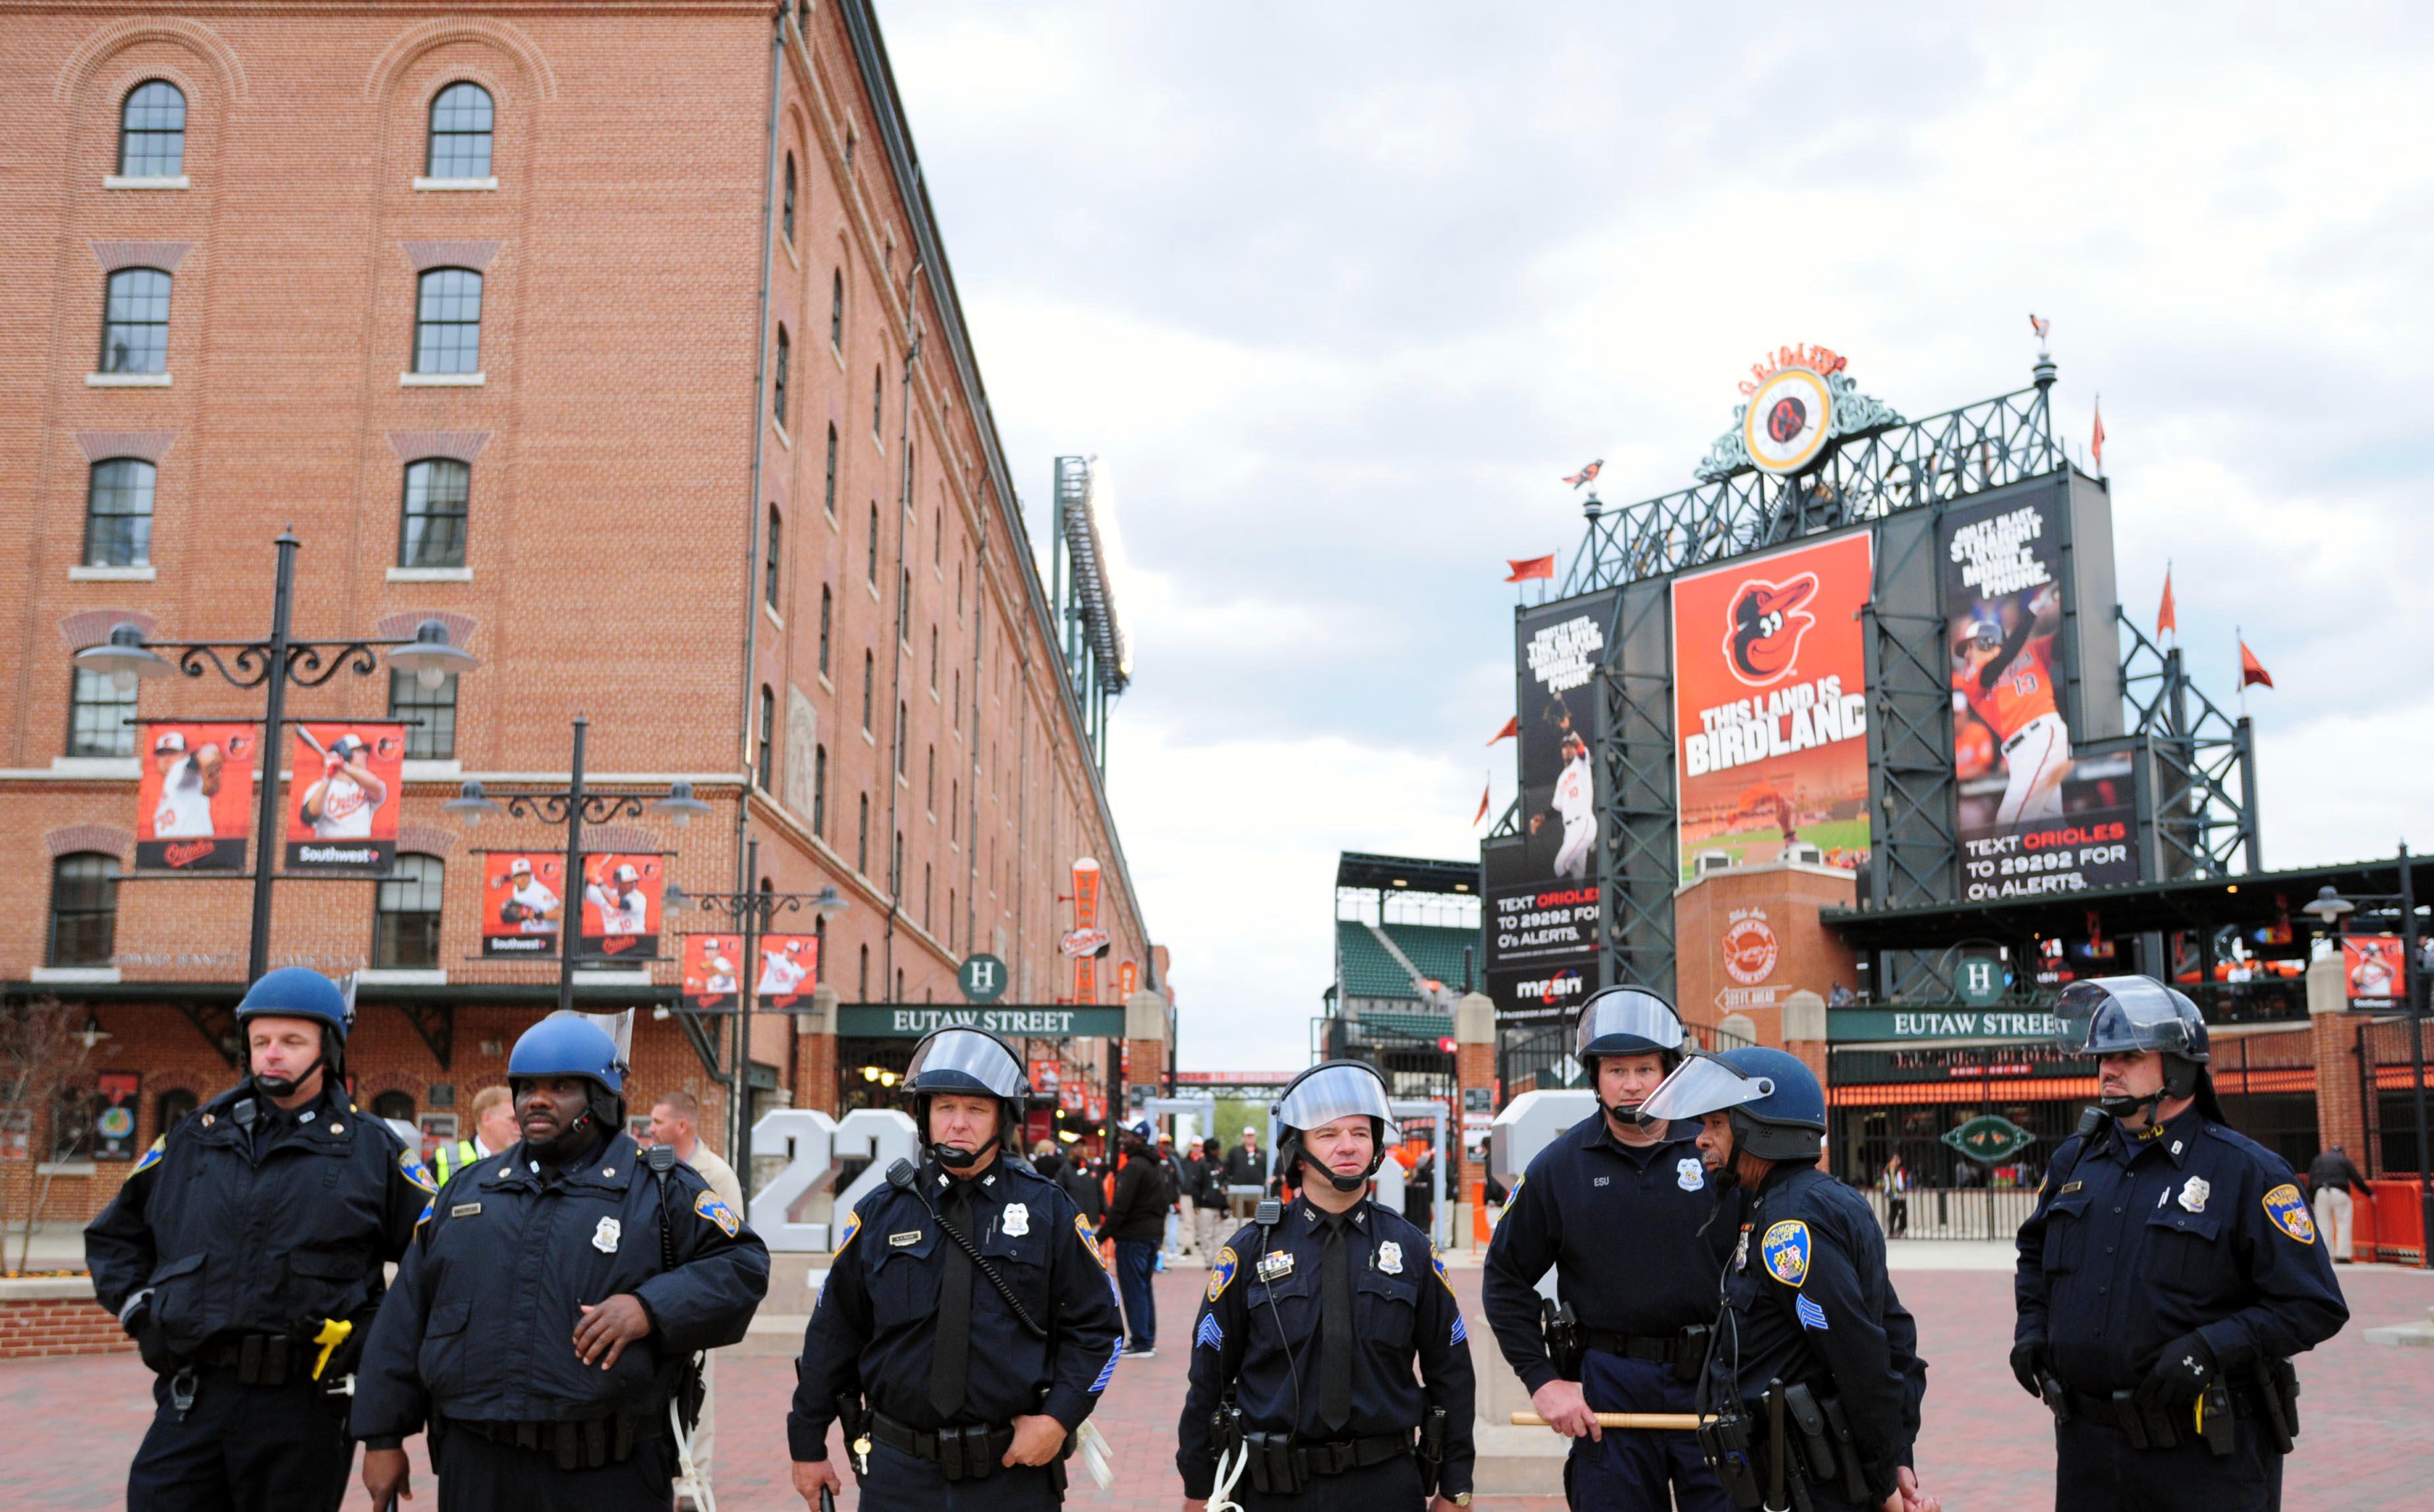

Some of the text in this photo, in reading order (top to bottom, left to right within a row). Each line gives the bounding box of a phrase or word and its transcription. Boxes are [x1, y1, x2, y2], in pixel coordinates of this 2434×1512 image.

[2014, 671, 2038, 696] 13
[1699, 674, 1842, 733] THIS LAND IS
[1685, 692, 1867, 778] BIRDLAND
[1965, 822, 2126, 857] TEXT ORIOLES
[300, 845, 370, 864] Southwest
[1966, 859, 1995, 879] TO
[2080, 844, 2127, 866] FOR
[1967, 872, 2087, 901] O's ALERTS.
[1497, 894, 1536, 913] TEXT
[1497, 915, 1518, 931] TO
[491, 937, 540, 951] Southwest
[1497, 926, 1580, 949] O's ALERTS.
[970, 961, 995, 988] H
[1967, 963, 1992, 990] H
[893, 1009, 1075, 1032] EUTAW STREET
[1894, 1012, 2072, 1035] EUTAW STREET
[1593, 1175, 1610, 1187] ESU
[1765, 1224, 1801, 1248] BALTIMORE
[1769, 1232, 1794, 1250] POLICE
